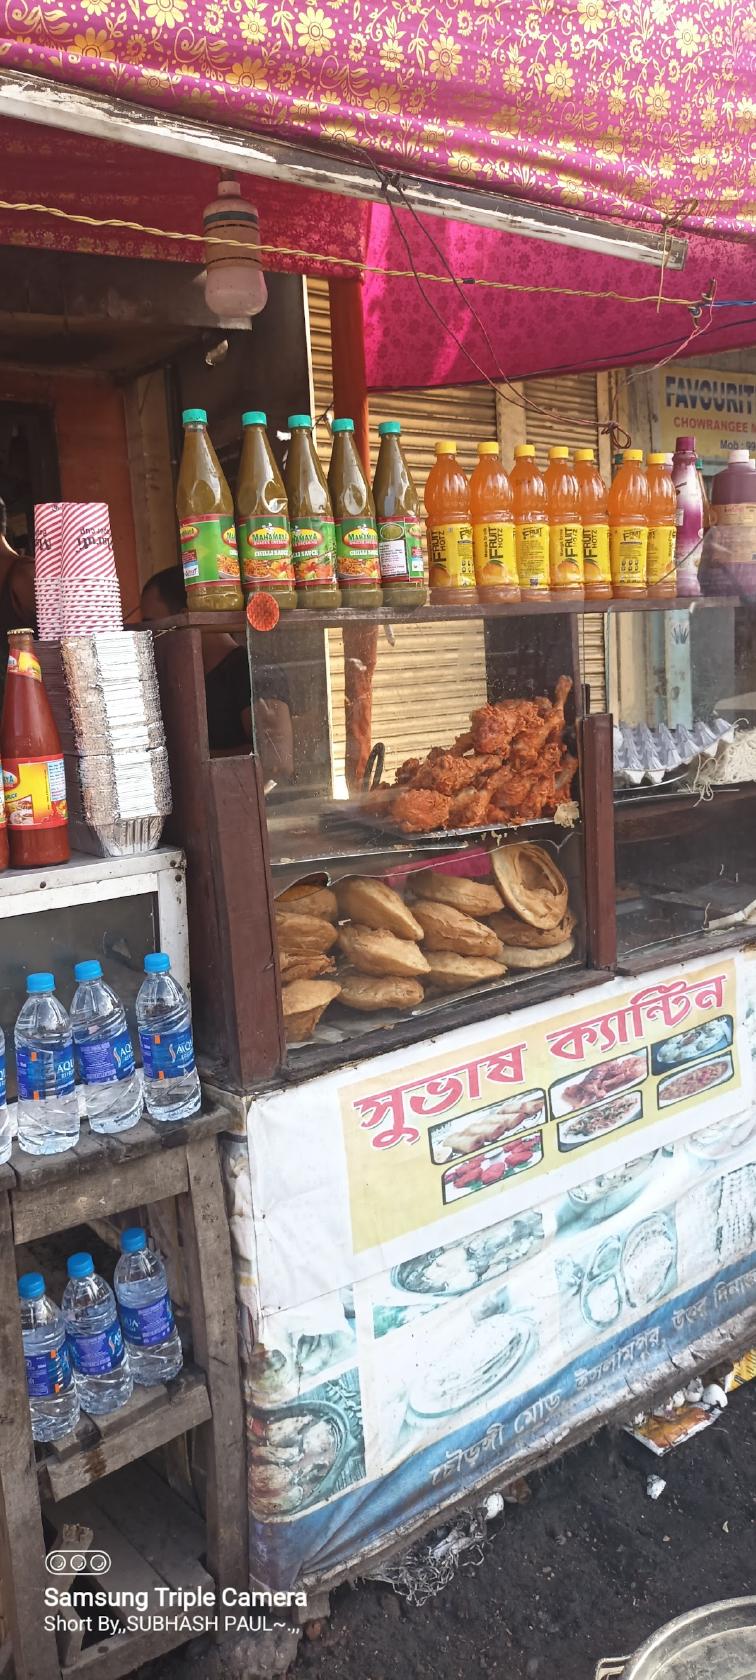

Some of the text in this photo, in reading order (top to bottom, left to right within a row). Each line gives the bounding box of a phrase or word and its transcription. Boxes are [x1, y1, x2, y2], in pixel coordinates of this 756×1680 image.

[666, 376, 756, 415] FAVOURIT
[673, 416, 748, 433] CHOWRANGEE
[432, 530, 447, 563] FRUIT
[489, 527, 504, 560] FRUIT
[564, 527, 578, 558] FRUIT
[583, 528, 597, 559] FRUIT
[353, 974, 727, 1149] সুভাষ ক্যান্টিন
